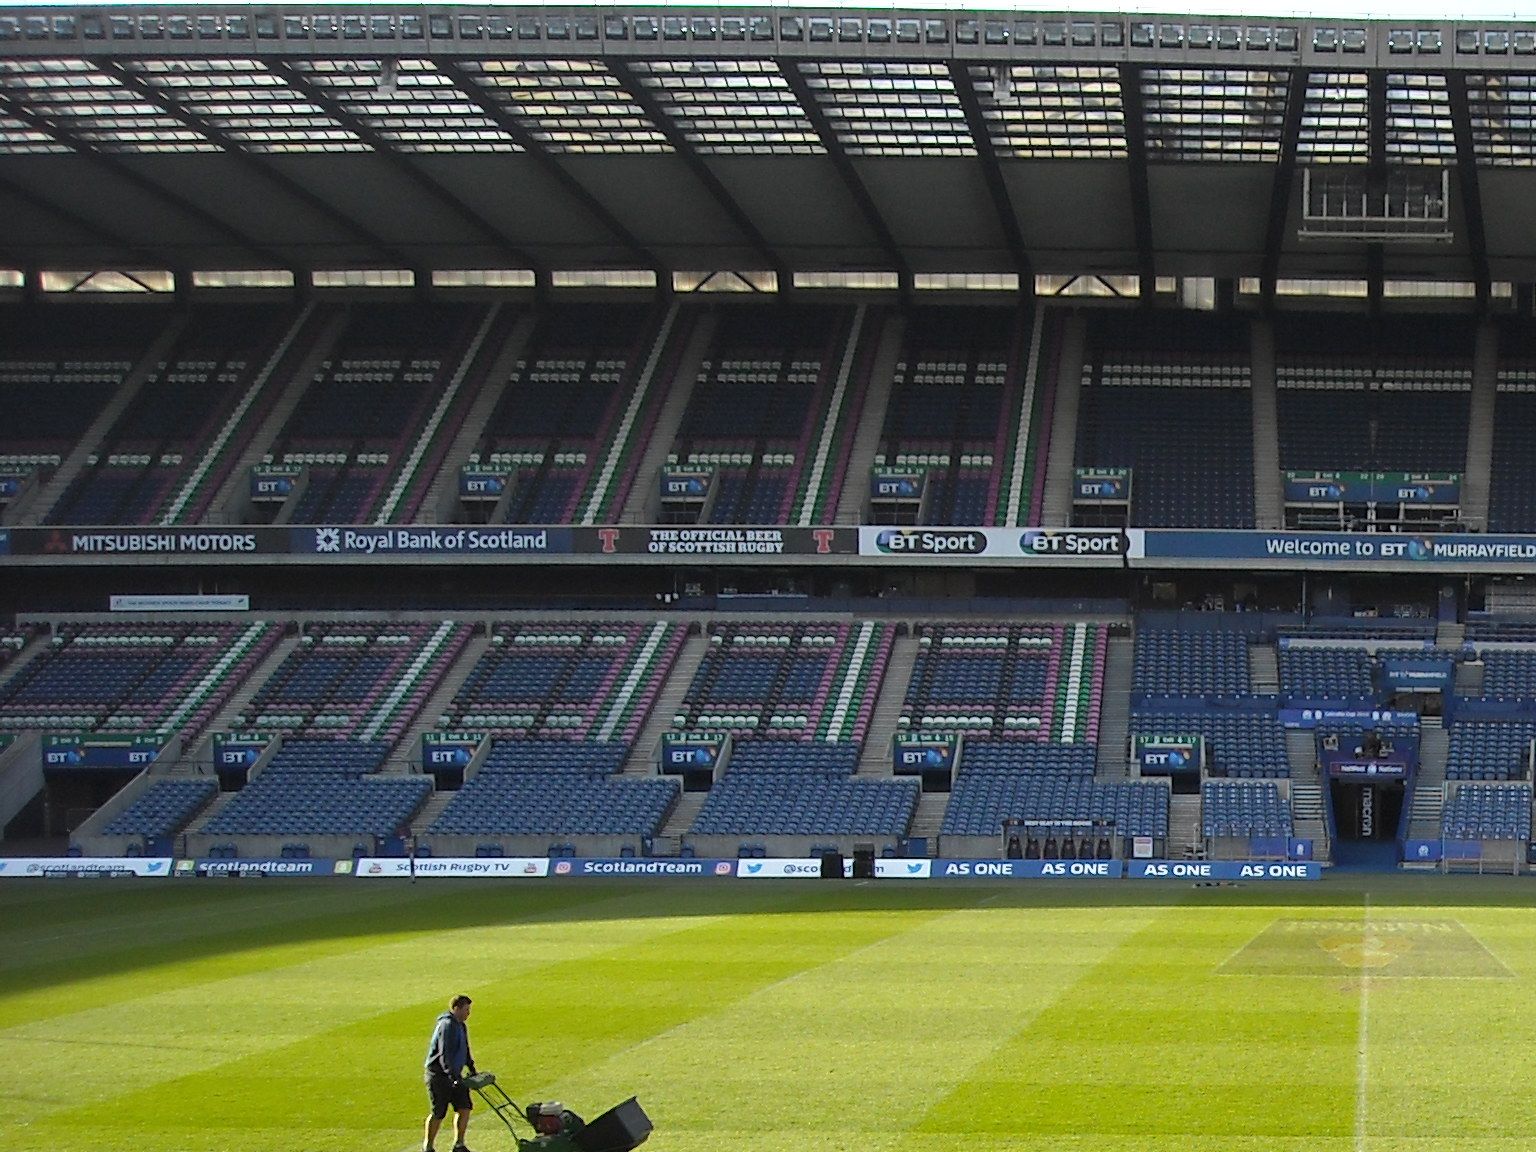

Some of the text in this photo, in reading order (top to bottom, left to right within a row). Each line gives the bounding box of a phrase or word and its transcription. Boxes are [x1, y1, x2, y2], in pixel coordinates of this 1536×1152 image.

[258, 481, 277, 492] BT
[467, 481, 487, 492] BT
[669, 481, 689, 493] BT
[879, 483, 899, 494] BT
[1081, 484, 1101, 495] BT
[1309, 486, 1328, 498] BT
[1398, 487, 1417, 499] BT
[345, 531, 546, 549] Royal Bank of Scotland
[650, 530, 782, 541] THE OFFICIAL BEER
[72, 535, 256, 551] MITSUBISHI MOTORS
[889, 532, 976, 551] BT Sport
[1032, 533, 1119, 552] BT Sport
[649, 542, 784, 553] OF SCOTTISH RUGBY
[1265, 538, 1536, 558] Welcome to BT MURRAYFIELD
[47, 752, 68, 763] BT
[129, 752, 149, 762] BT
[223, 752, 245, 763] BT
[432, 751, 454, 762] BT
[672, 751, 694, 763] BT
[903, 753, 926, 764] BT
[1145, 754, 1167, 765] BT
[200, 862, 313, 873] scotlandteam
[451, 863, 490, 873] Rugby
[495, 863, 509, 871] TV
[584, 862, 702, 873] ScotlandTeam
[946, 863, 1013, 875] AS ONE
[1042, 863, 1109, 875] AS ONE
[1144, 865, 1211, 876] AS ONE
[1241, 866, 1307, 877] AS ONE
